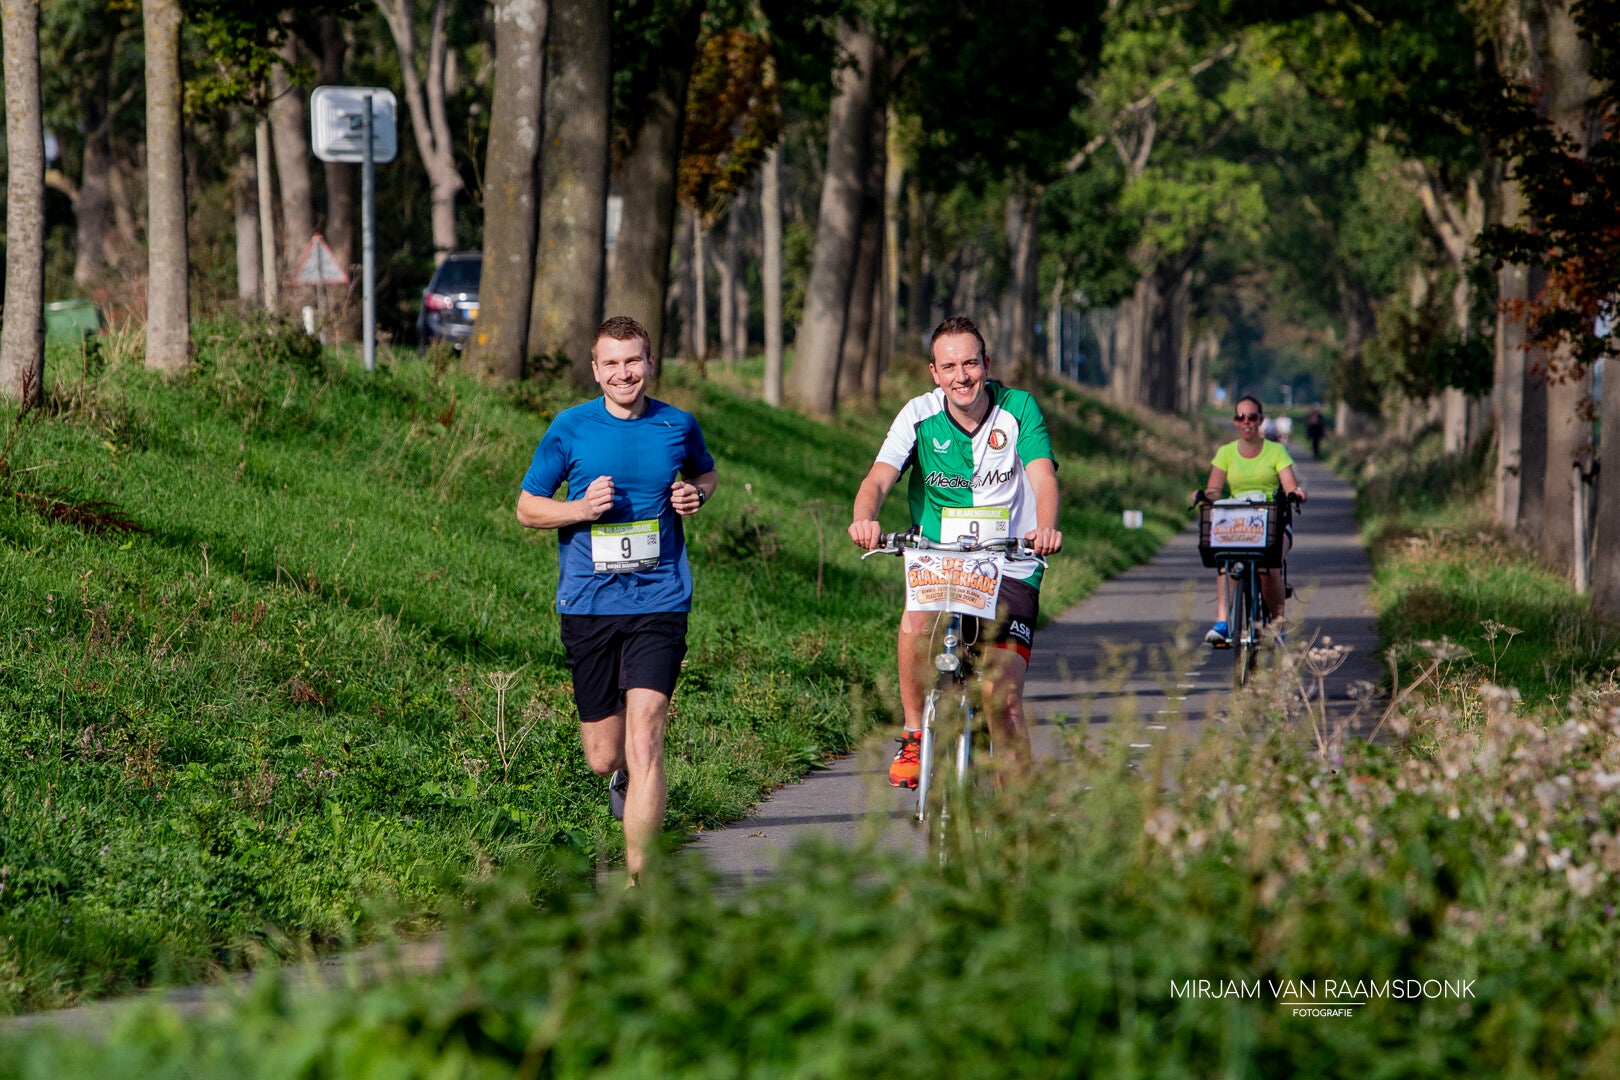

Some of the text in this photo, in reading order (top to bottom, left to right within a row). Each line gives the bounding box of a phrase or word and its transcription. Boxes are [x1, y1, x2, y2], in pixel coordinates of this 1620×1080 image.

[925, 470, 969, 488] Media
[969, 521, 979, 540] 9
[621, 537, 632, 559] 9
[942, 556, 965, 572] DE
